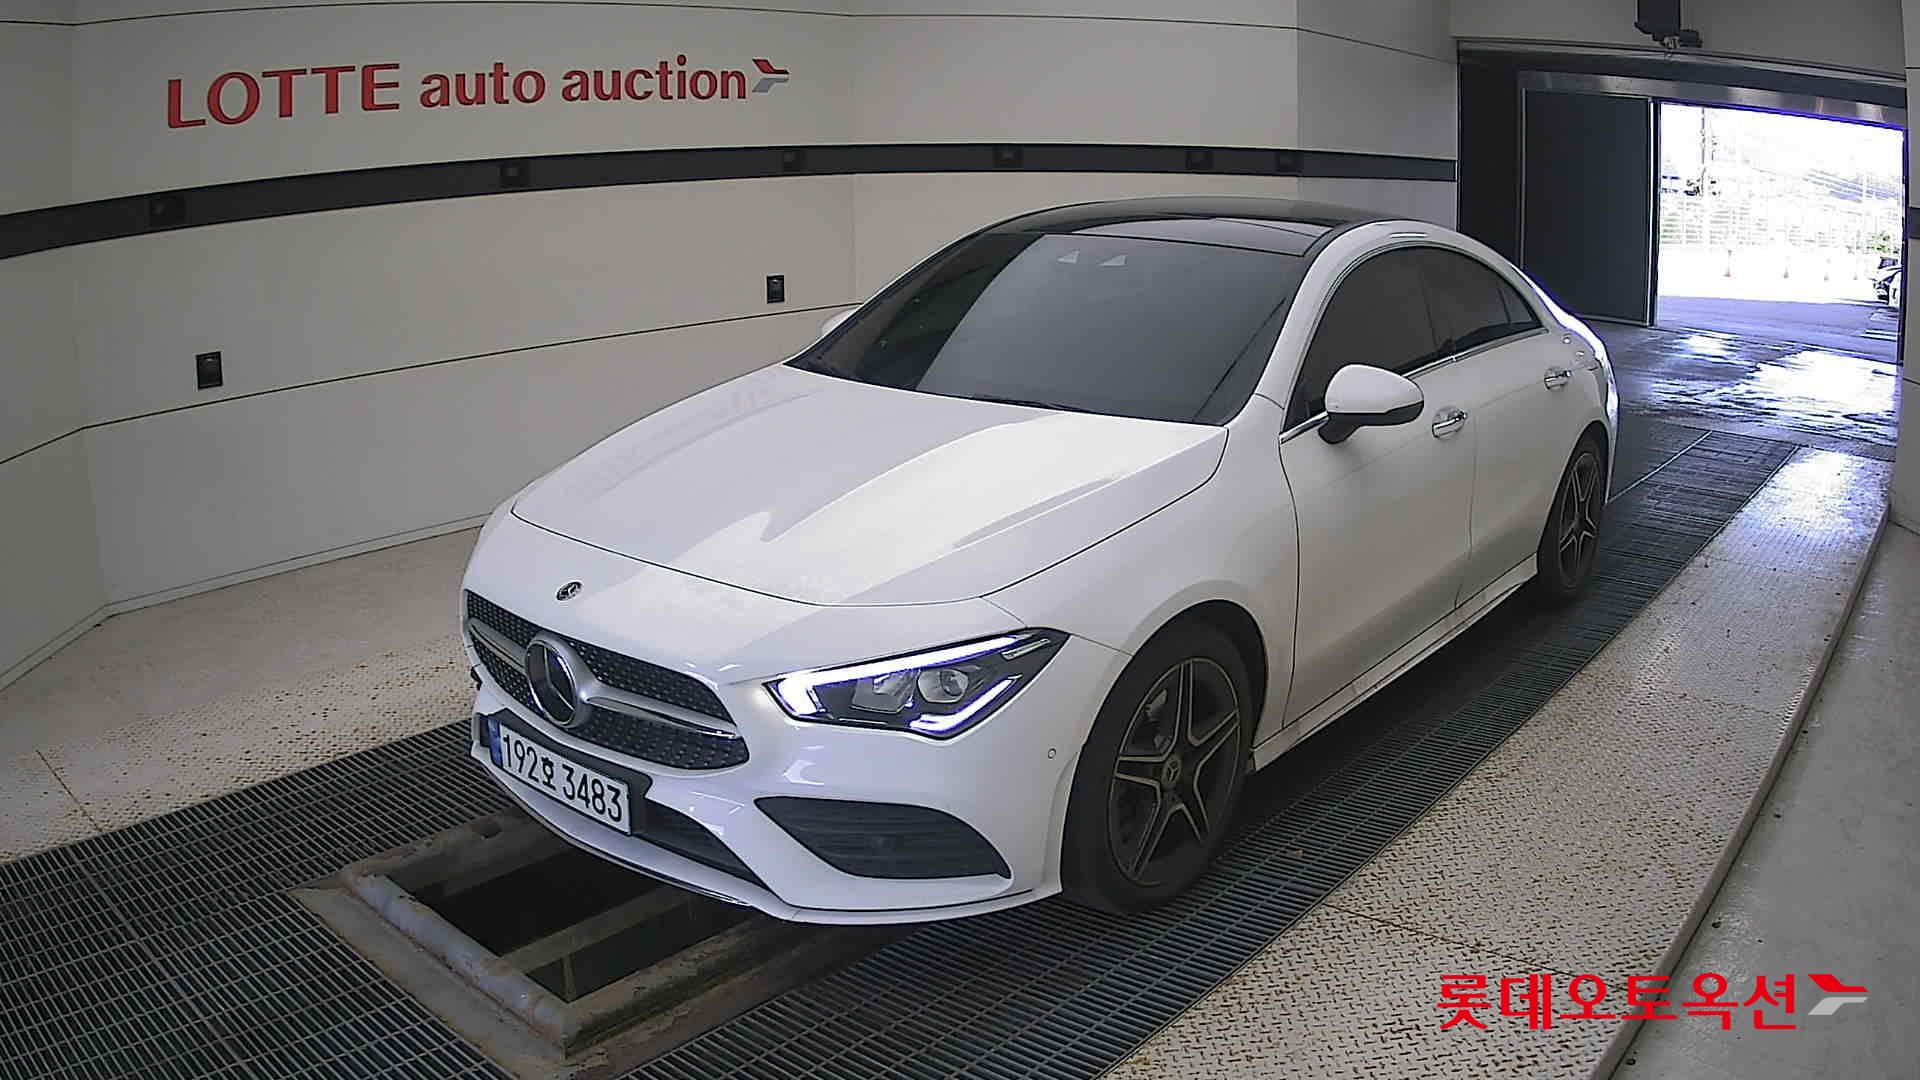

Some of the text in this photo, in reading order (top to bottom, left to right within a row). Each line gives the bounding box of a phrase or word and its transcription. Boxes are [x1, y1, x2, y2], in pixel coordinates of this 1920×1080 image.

[167, 53, 748, 129] LOTTE auto auction
[561, 763, 623, 823] 3483
